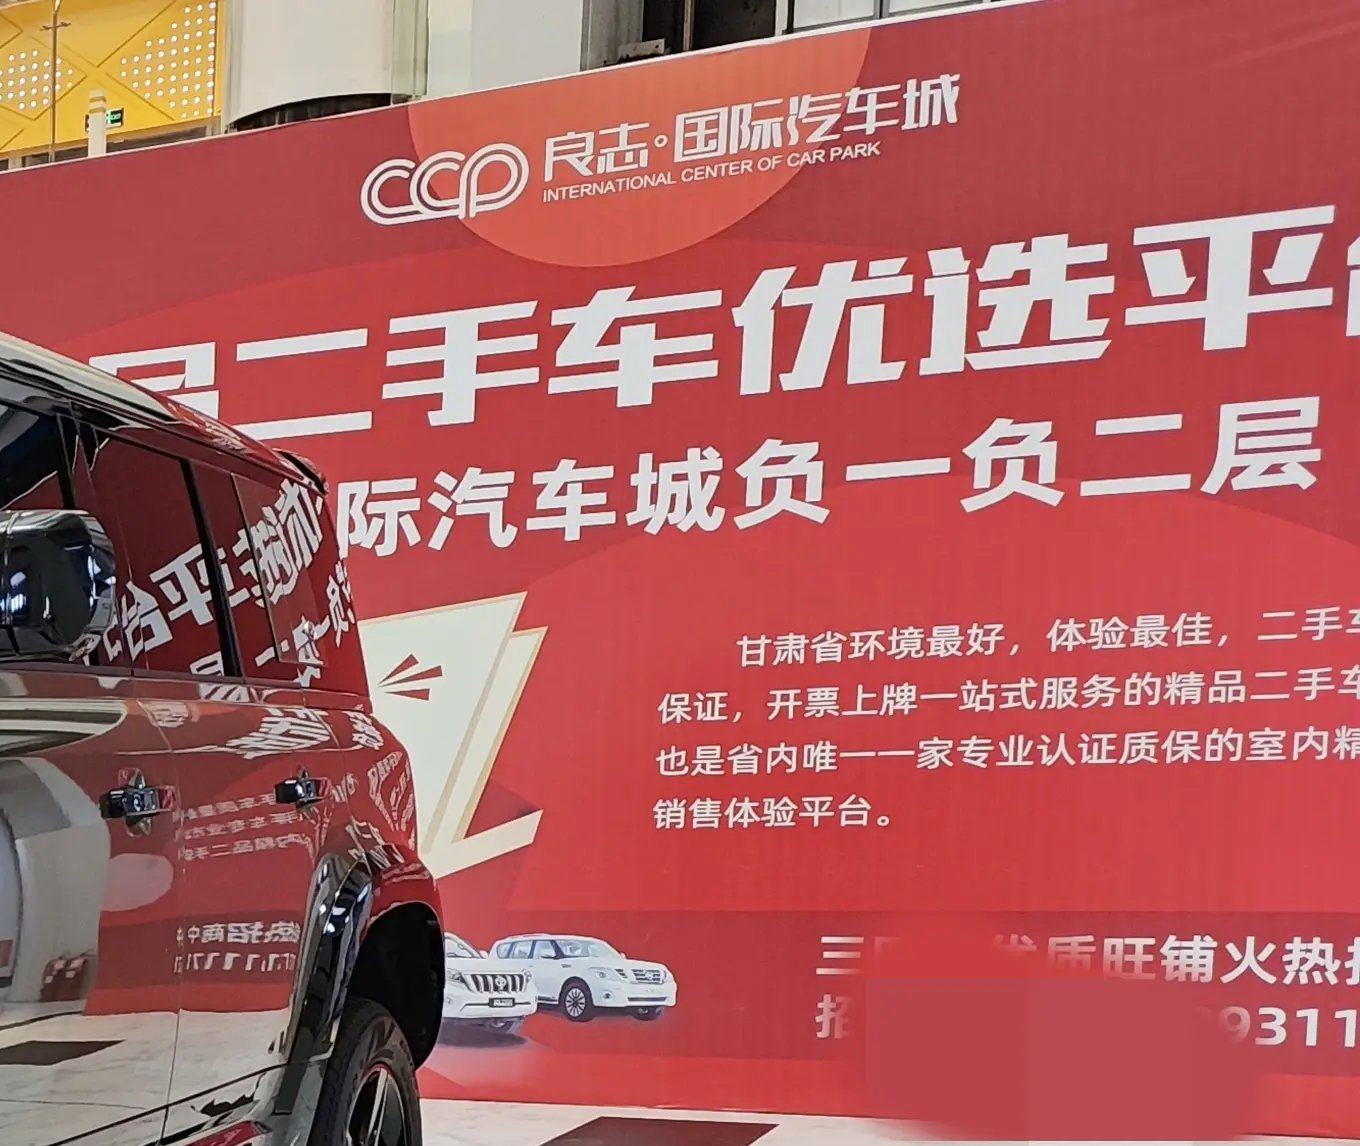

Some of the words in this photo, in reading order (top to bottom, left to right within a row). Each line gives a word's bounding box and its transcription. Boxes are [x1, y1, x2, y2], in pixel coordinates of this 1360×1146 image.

[542, 171, 677, 202] INTERNATIONAL
[681, 158, 753, 183] CENTER
[758, 155, 782, 172] OF
[786, 148, 826, 168] CAR
[829, 140, 882, 162] PARK
[89, 205, 1360, 440] 二手车优选平
[652, 794, 891, 830] 销售体验平台。
